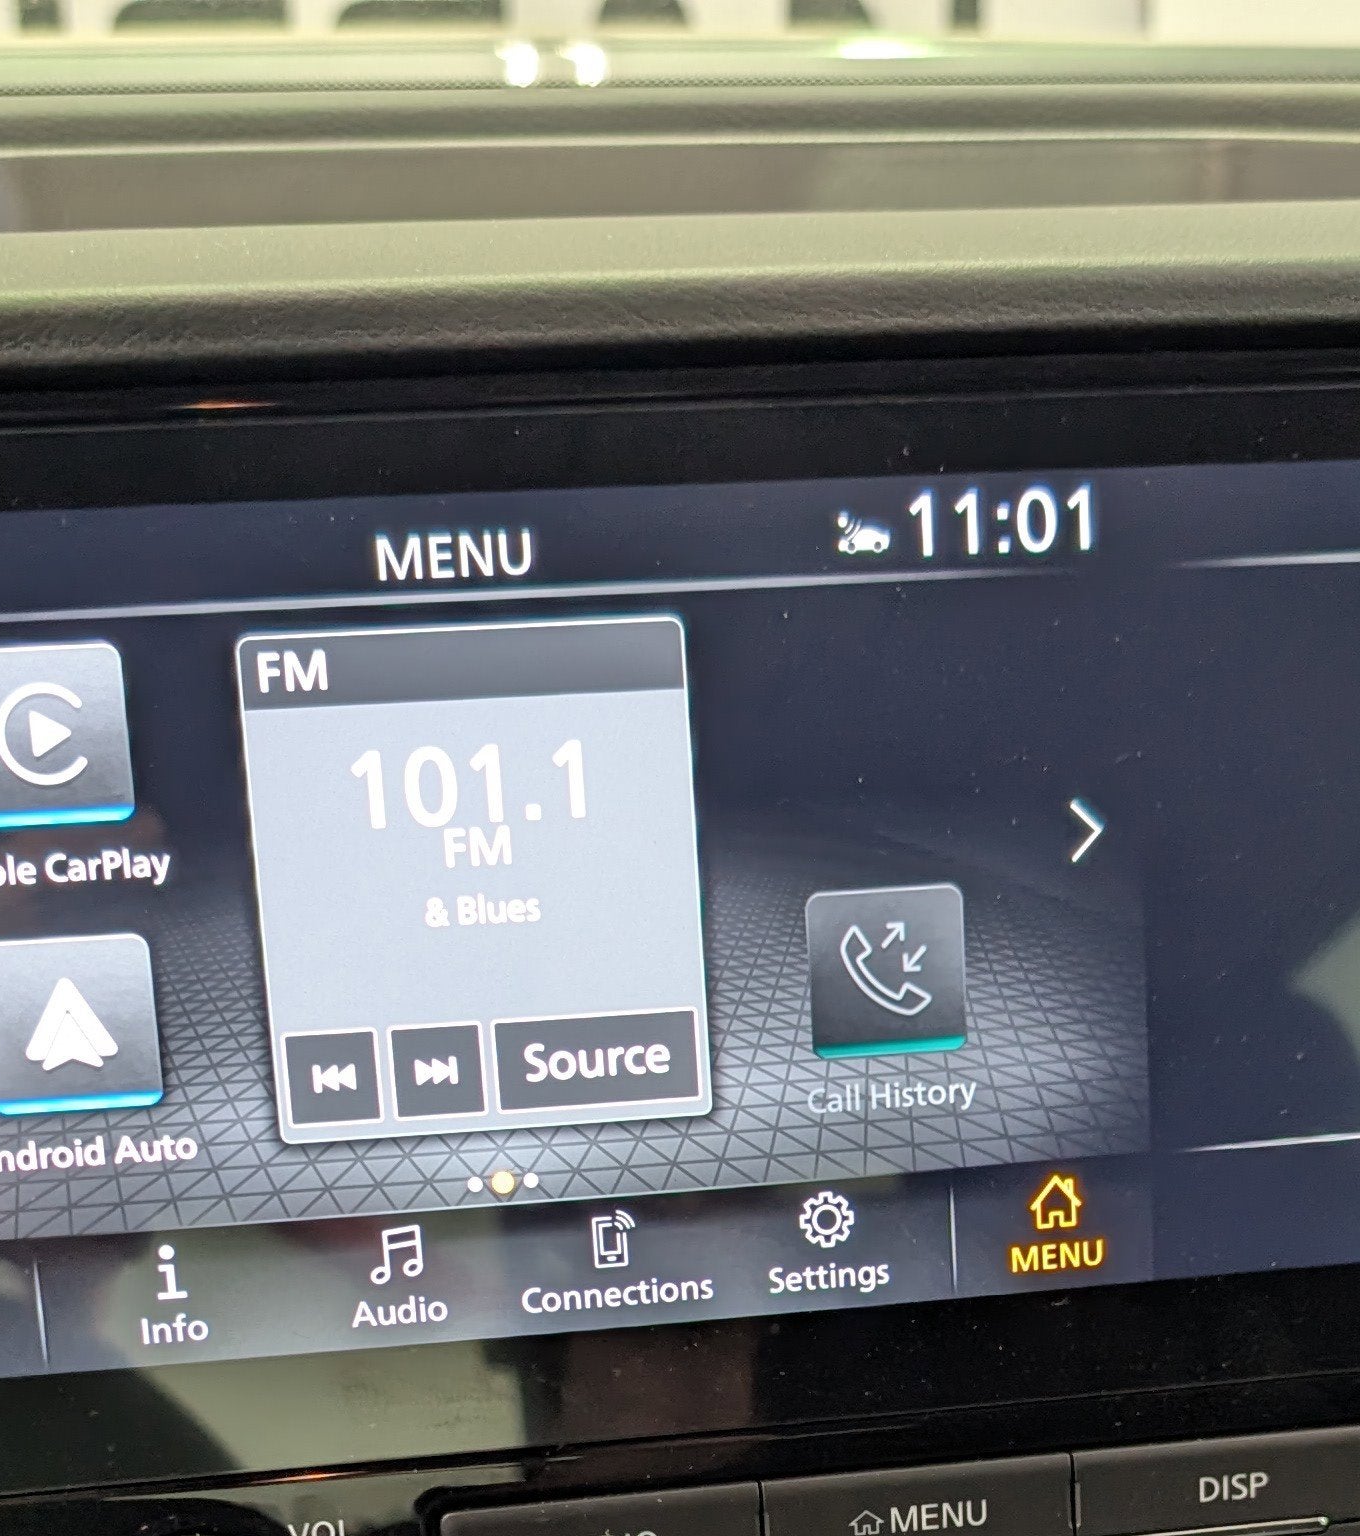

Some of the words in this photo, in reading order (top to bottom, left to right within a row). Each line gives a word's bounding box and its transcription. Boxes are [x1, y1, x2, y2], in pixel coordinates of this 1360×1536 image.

[908, 483, 1094, 558] 11:01
[374, 528, 534, 582] MENU
[256, 648, 330, 694] FM
[349, 738, 588, 831] 101.1
[442, 824, 514, 869] FM
[44, 847, 172, 886] CarPlay
[424, 896, 451, 928] &
[456, 891, 542, 926] Blues
[523, 1042, 672, 1083] Source
[805, 1083, 861, 1115] Call
[869, 1080, 978, 1111] History
[113, 1134, 199, 1165] Auto
[1009, 1238, 1106, 1274] MENU
[520, 1275, 715, 1315] Connections
[767, 1259, 891, 1296] Settings
[140, 1312, 210, 1346] Info
[351, 1295, 449, 1329] Audio
[1196, 1471, 1271, 1504] DISP
[889, 1499, 990, 1535] MENU
